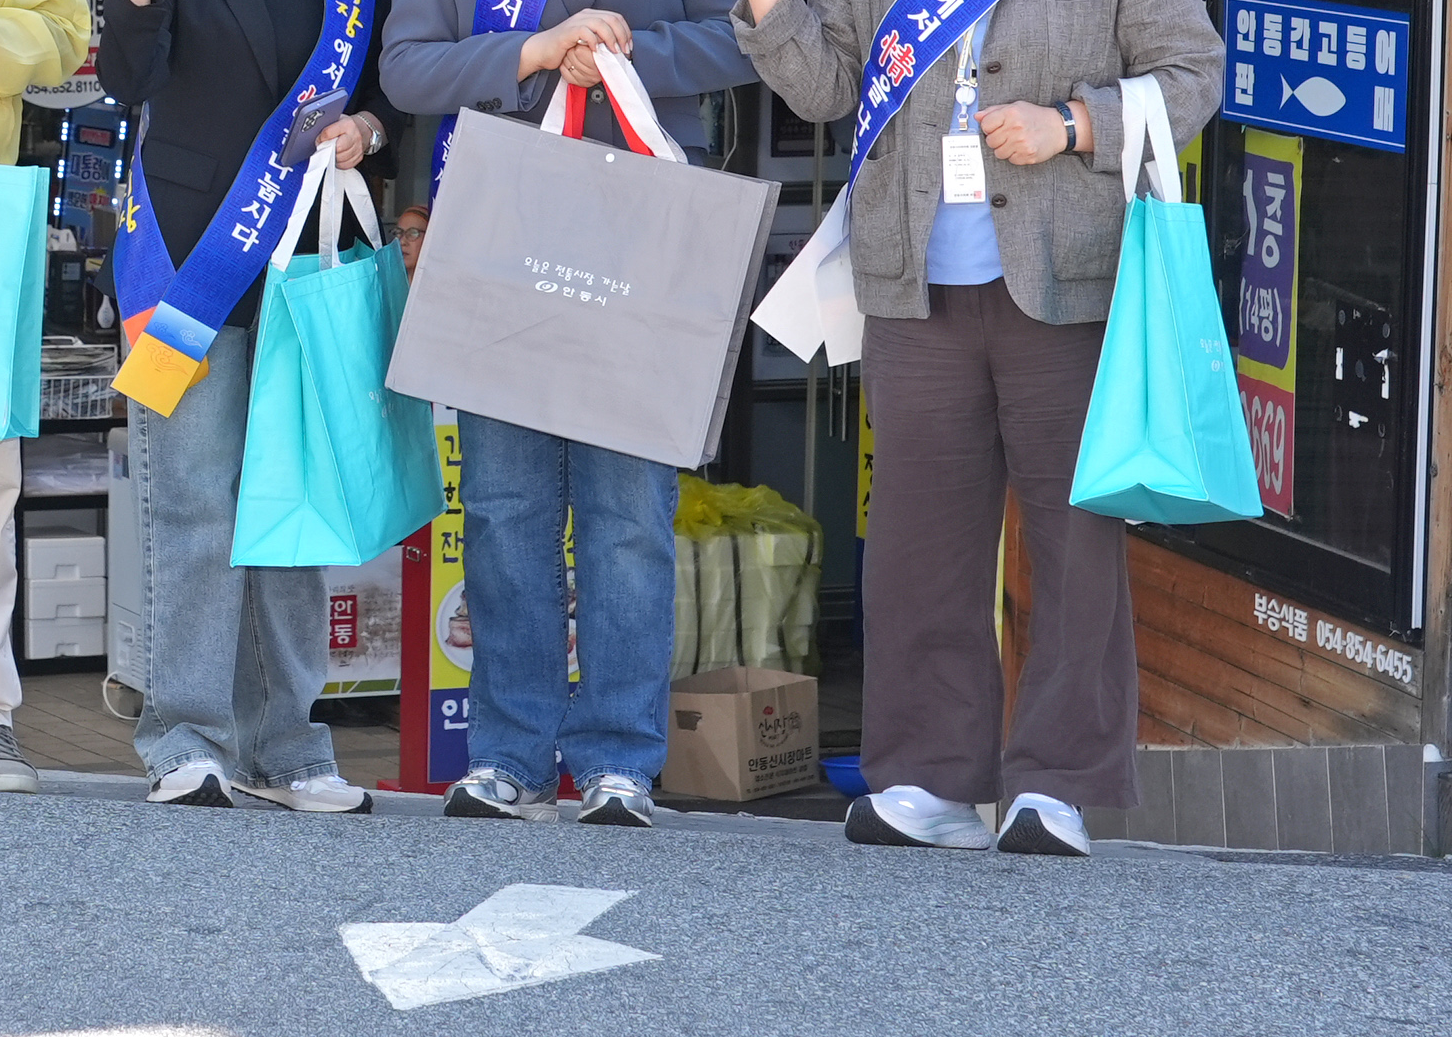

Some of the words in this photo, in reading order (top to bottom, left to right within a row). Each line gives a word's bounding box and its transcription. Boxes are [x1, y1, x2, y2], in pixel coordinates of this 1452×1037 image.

[523, 256, 551, 274] 오늘은
[555, 264, 595, 286] 전통시장
[1253, 592, 1308, 642] 부승식품
[1316, 618, 1413, 684] 054-854-6455
[748, 746, 813, 772] 안동신시장마트
